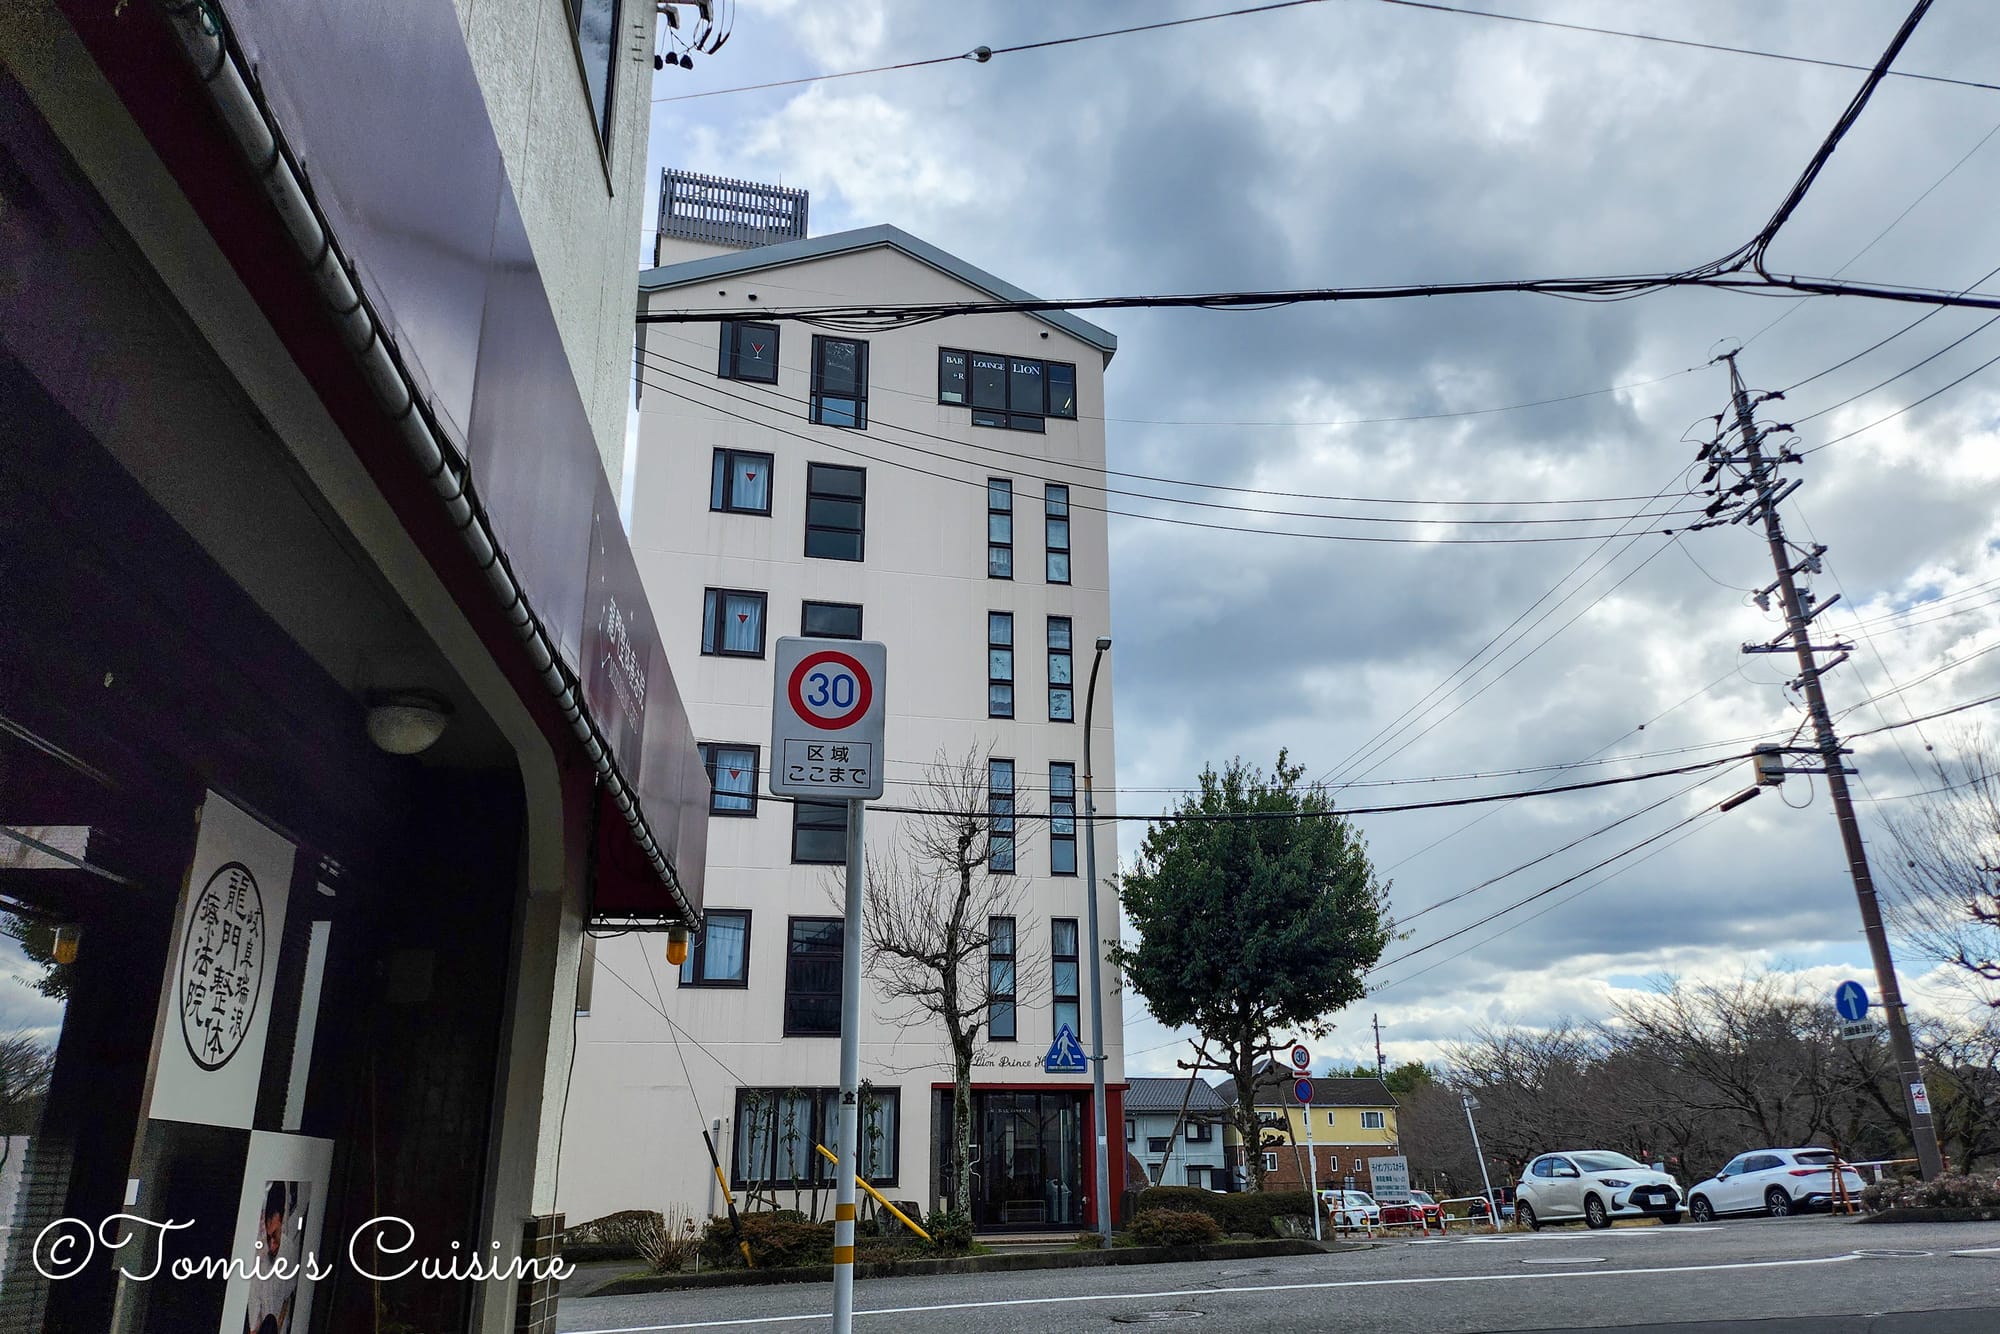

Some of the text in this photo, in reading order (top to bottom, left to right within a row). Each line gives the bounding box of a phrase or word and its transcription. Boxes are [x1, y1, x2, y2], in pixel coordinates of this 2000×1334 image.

[946, 356, 1040, 375] BAR LOUNGE LION
[808, 673, 854, 708] 30
[789, 765, 866, 784] ここまで
[971, 1053, 995, 1067] Lion
[999, 1056, 1031, 1067] Prince
[1296, 1050, 1306, 1063] 30
